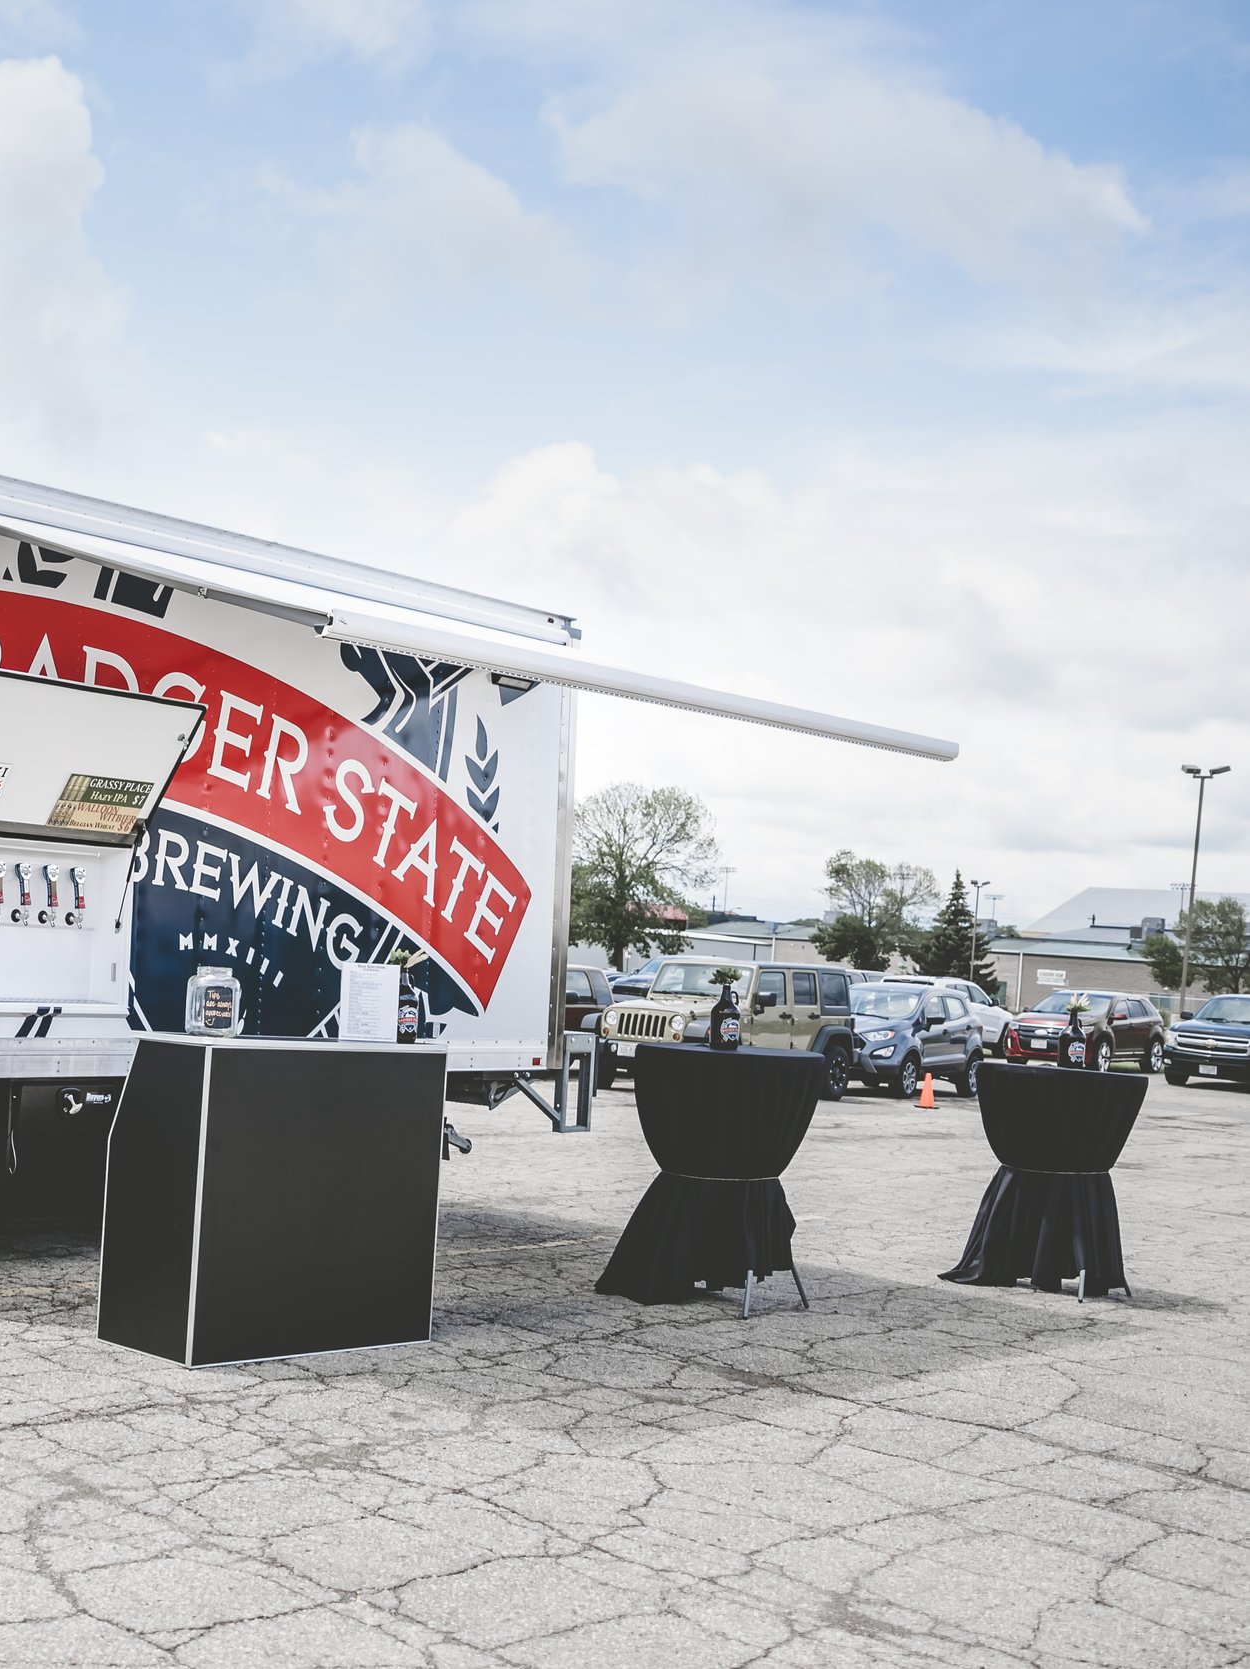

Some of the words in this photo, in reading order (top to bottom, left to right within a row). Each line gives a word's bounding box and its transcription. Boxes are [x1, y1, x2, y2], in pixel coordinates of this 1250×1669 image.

[90, 778, 125, 790] GRASSY
[124, 782, 153, 794] PLACE
[112, 793, 128, 803] IPA
[132, 795, 146, 806] $7
[77, 802, 120, 814] WALLOON
[99, 813, 137, 824] WITBIER
[117, 822, 131, 832] $6
[323, 759, 516, 964] STATE
[179, 932, 284, 988] MMXIII
